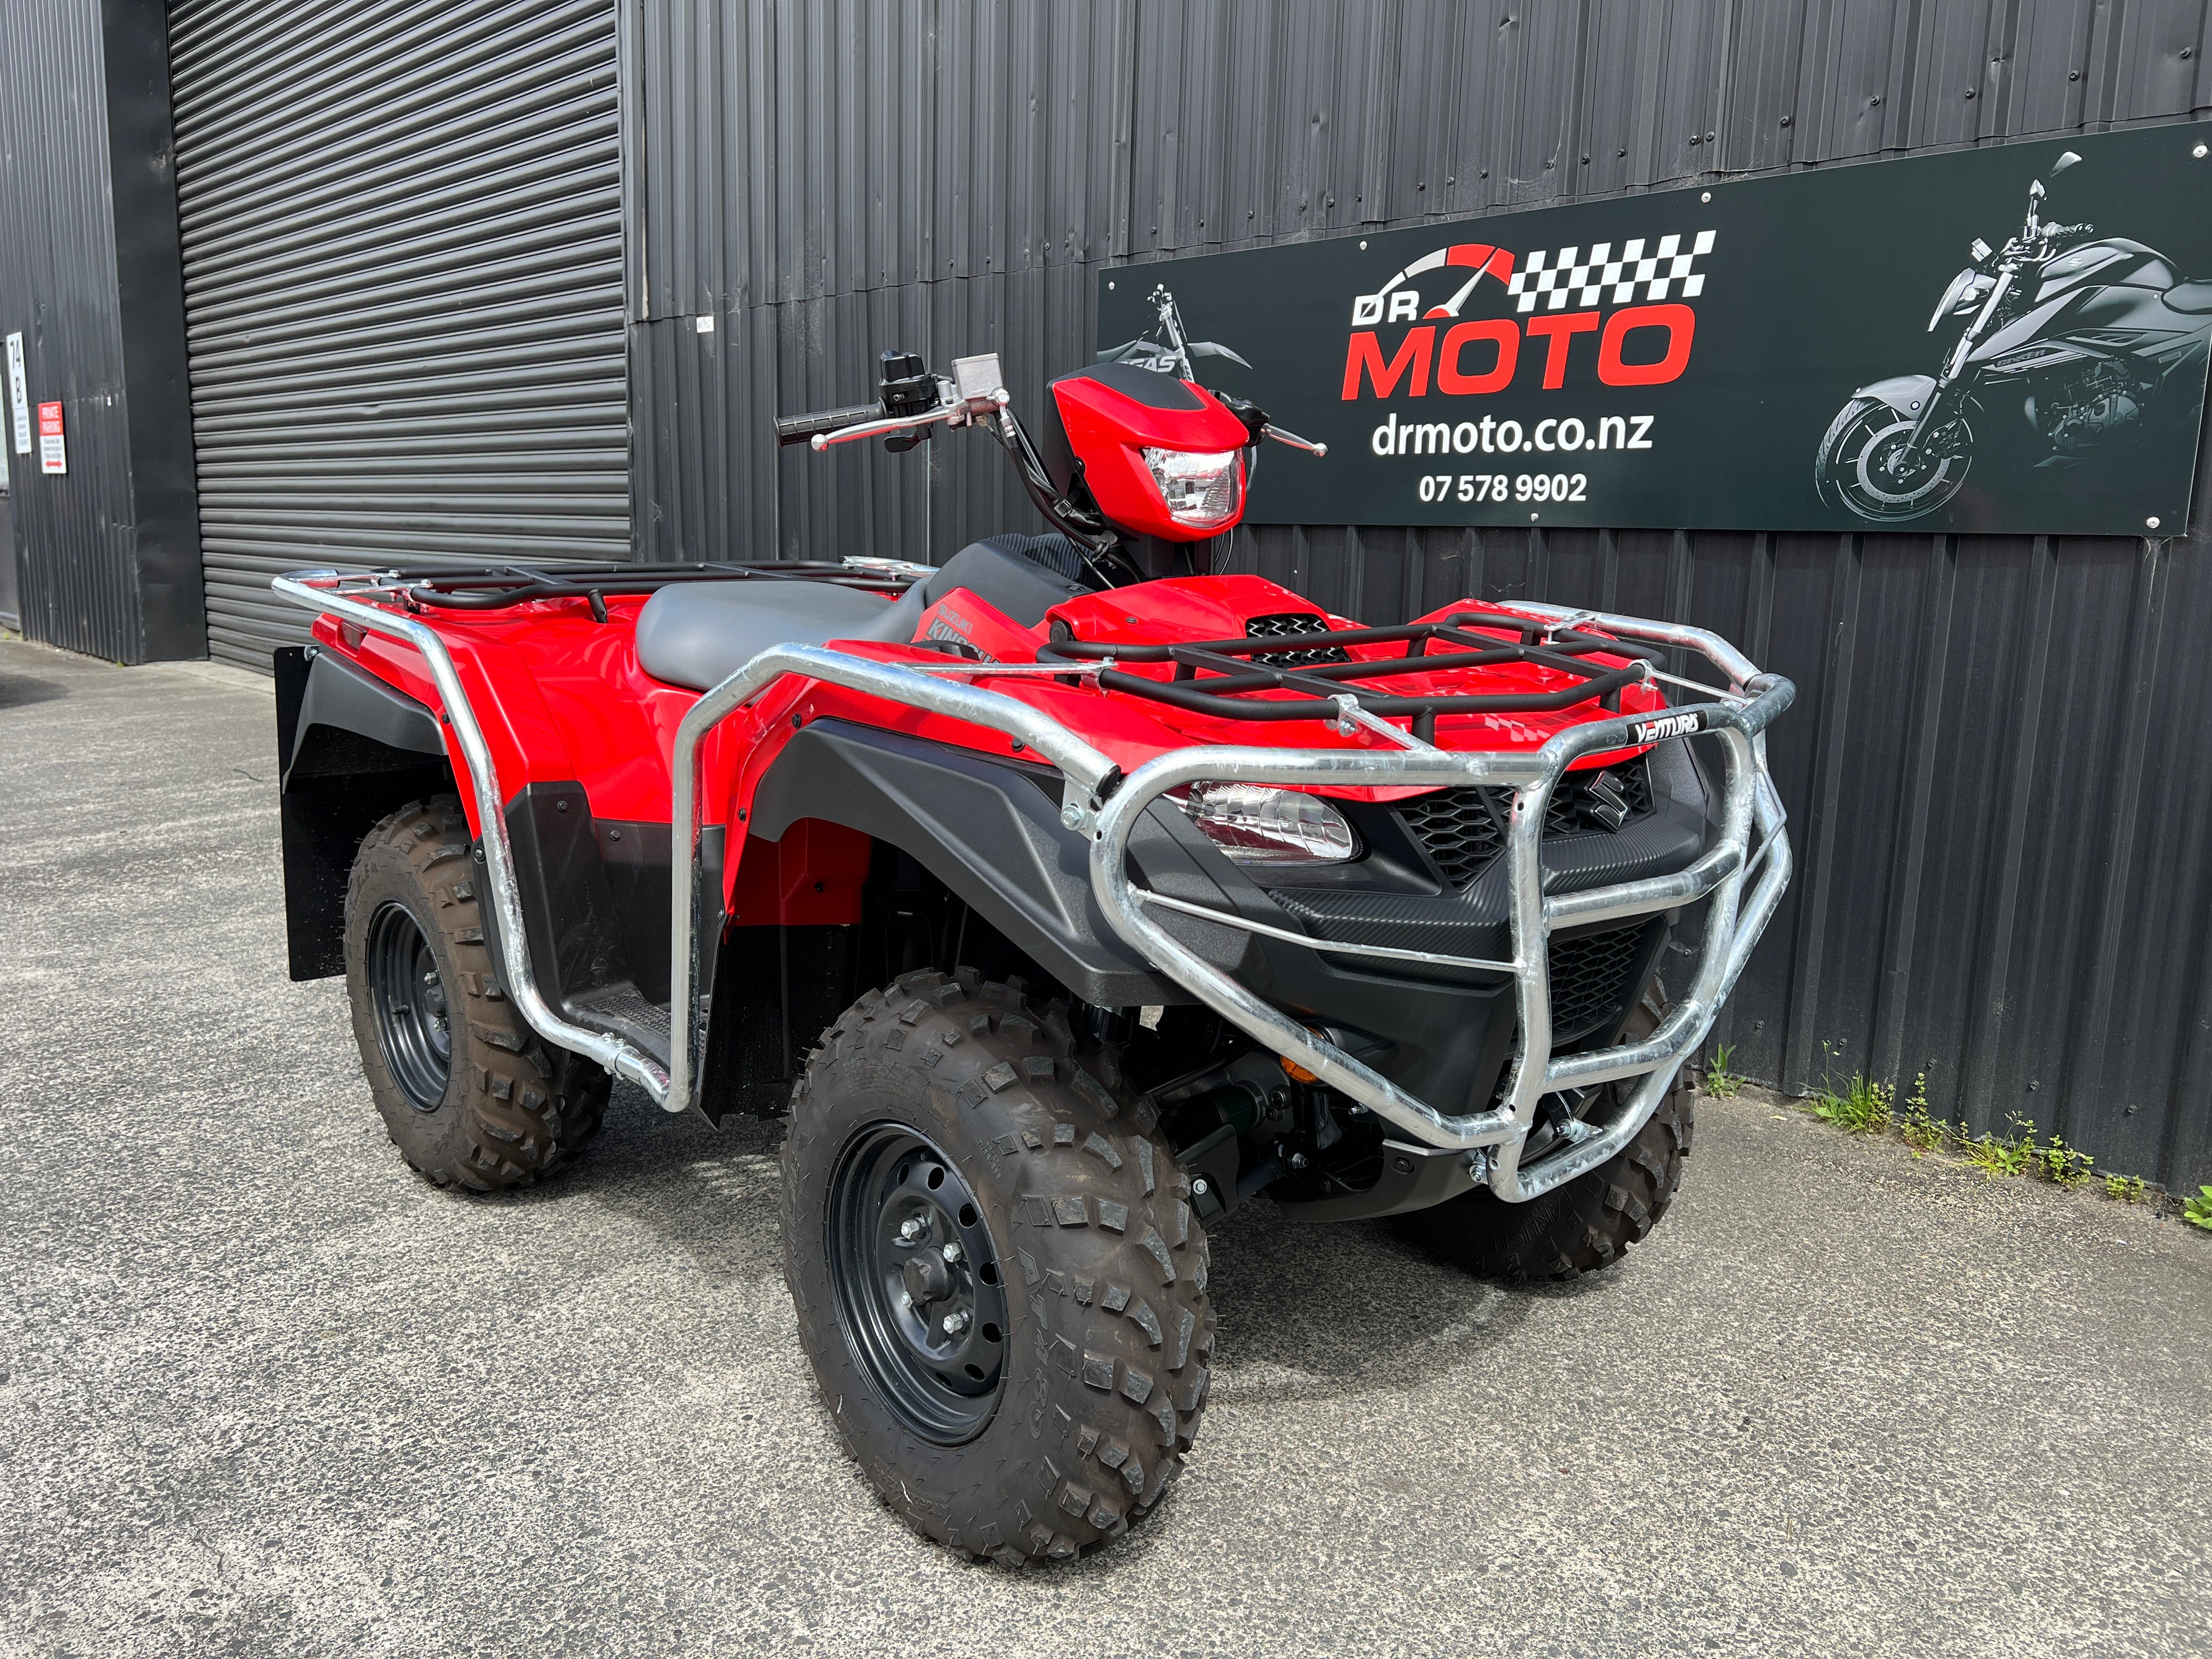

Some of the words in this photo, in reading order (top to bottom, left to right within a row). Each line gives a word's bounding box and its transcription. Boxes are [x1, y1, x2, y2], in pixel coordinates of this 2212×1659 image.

[1352, 290, 1420, 326] DR
[1116, 356, 1177, 373] GAS
[1342, 304, 1695, 400] MOTO
[1373, 413, 1654, 455] drmoto.co.nz
[1420, 476, 1452, 501] 07
[1458, 475, 1508, 501] 578
[1515, 473, 1587, 501] 9902
[938, 603, 973, 635] SUZUKI
[1635, 713, 1699, 743] VENTURA
[787, 1150, 808, 1312] CARLISLE
[1017, 1246, 1049, 1440] AT489
